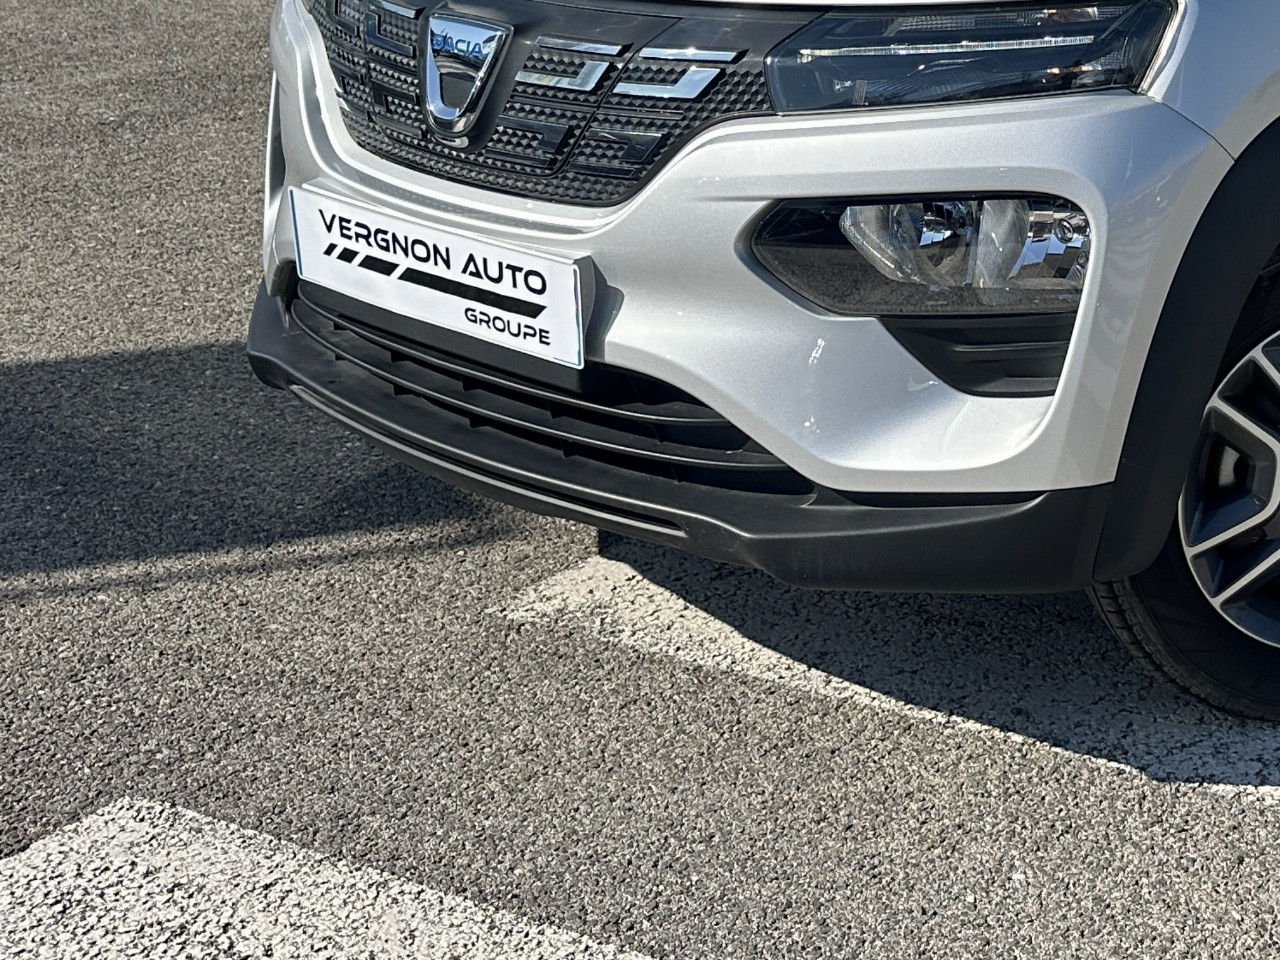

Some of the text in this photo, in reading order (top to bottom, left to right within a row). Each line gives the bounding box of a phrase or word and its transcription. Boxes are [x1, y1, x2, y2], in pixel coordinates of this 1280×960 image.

[432, 33, 484, 58] DACIA
[318, 209, 547, 295] VERGNON AUTO
[464, 307, 551, 346] GROUPE
